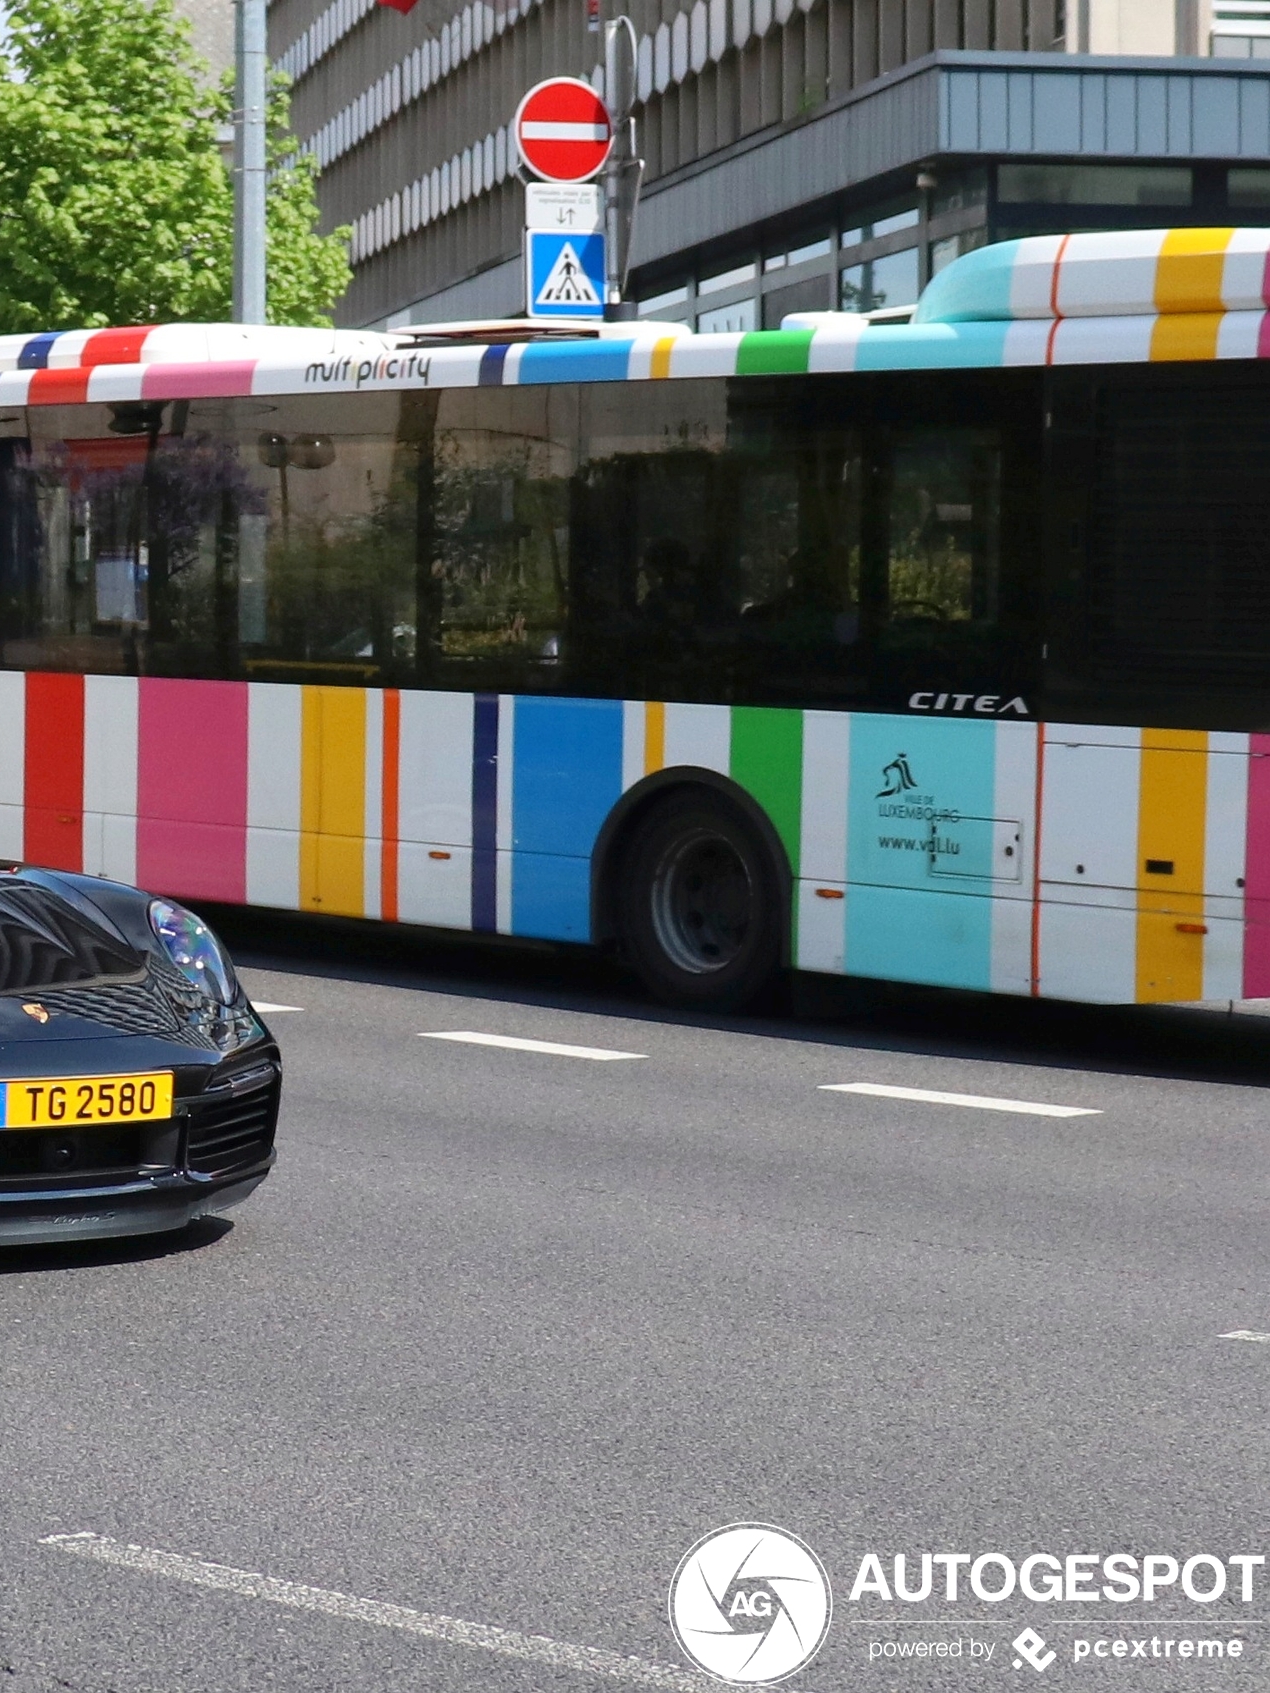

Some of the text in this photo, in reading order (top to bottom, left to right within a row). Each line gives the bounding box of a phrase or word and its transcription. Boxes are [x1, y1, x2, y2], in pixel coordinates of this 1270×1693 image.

[305, 351, 432, 390] multiplicity
[908, 692, 1029, 714] CITEA
[879, 803, 959, 823] LUXEMBOURG
[26, 1081, 156, 1121] TG 2580
